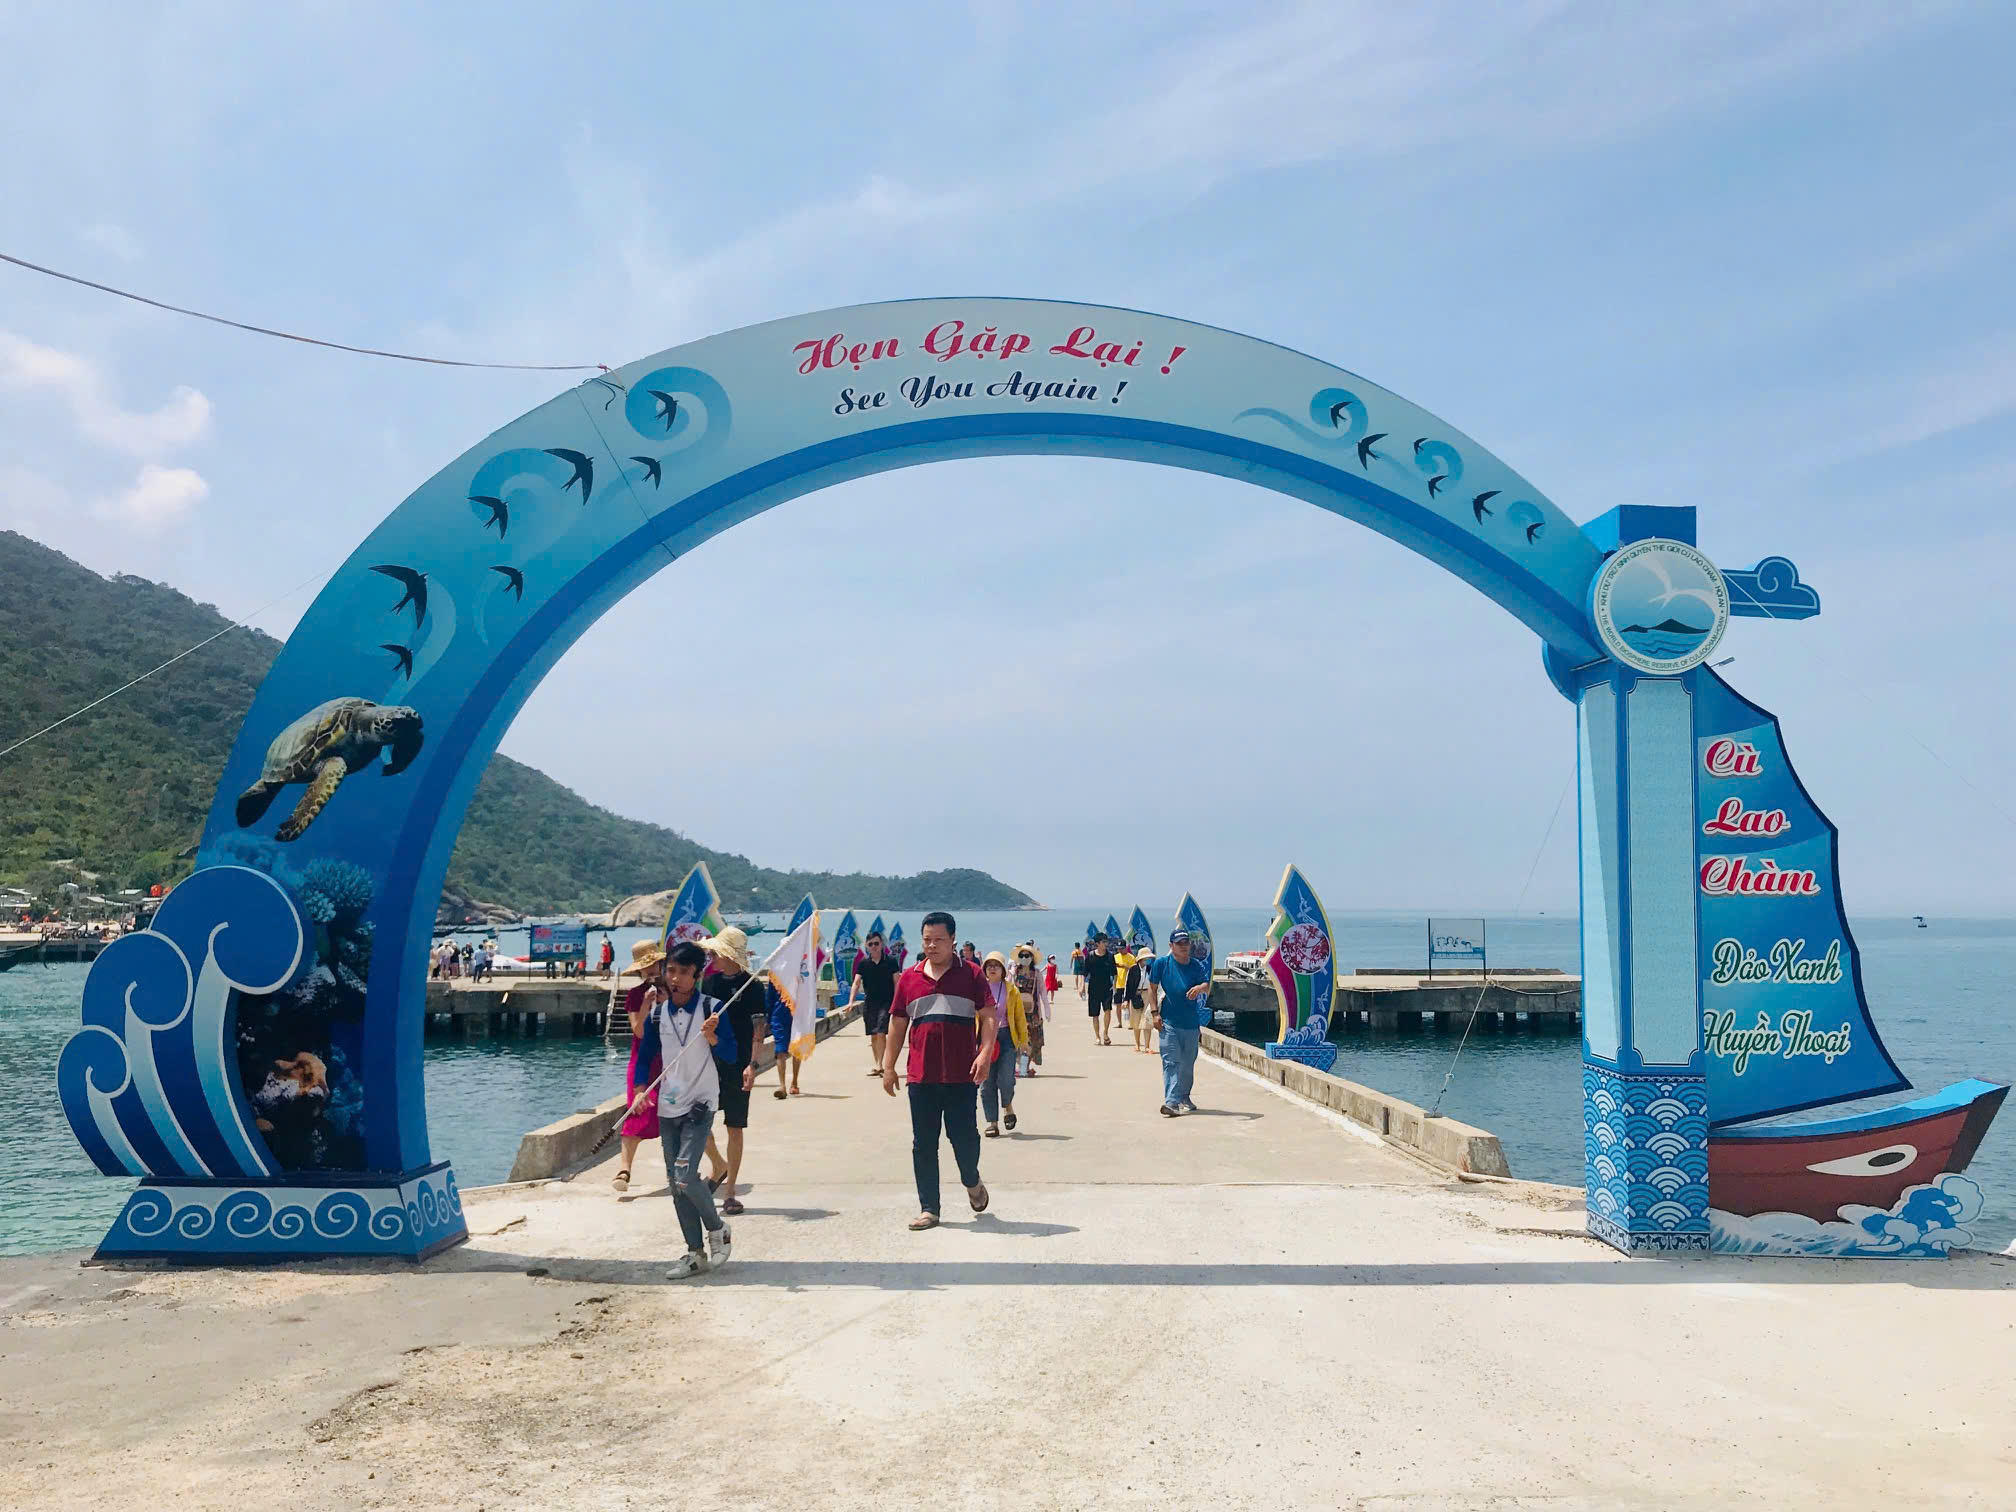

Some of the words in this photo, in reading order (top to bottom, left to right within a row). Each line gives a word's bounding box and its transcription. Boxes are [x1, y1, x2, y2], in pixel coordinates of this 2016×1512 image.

[793, 333, 904, 374] Hẹn
[919, 320, 1033, 362] Gặp
[1049, 326, 1142, 368] Lại
[1161, 346, 1186, 374] !
[834, 388, 888, 415] See
[900, 375, 976, 408] You
[986, 371, 1099, 402] Again
[1111, 381, 1128, 404] !
[1605, 626, 1622, 647] WORLD
[1680, 658, 1688, 667] OF
[1705, 739, 1763, 774] Cù
[1704, 798, 1790, 833] Lao
[1701, 857, 1820, 893] Chàm
[1712, 940, 1770, 984] Đảo
[1772, 940, 1841, 981] Xanh
[1703, 1011, 1780, 1073] Huyền
[1782, 1012, 1849, 1062] Thoại
